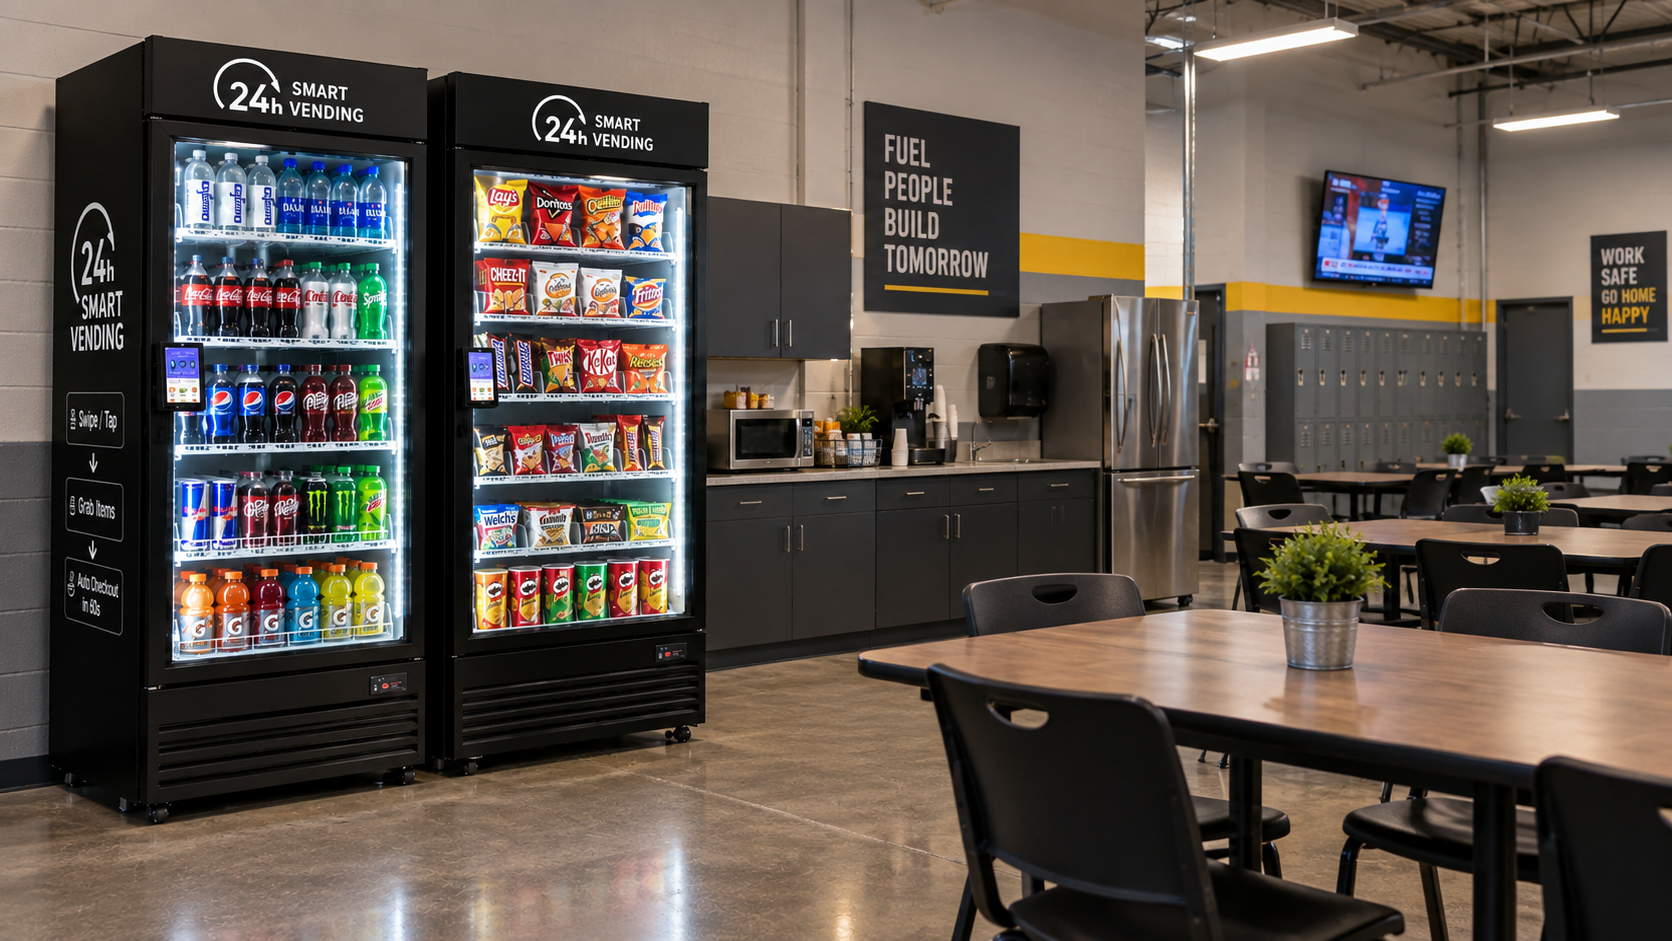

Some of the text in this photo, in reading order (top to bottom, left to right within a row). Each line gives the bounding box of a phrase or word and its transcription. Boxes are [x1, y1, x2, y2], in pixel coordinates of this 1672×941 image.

[229, 81, 283, 115] 24h
[291, 81, 349, 101] SMART
[289, 101, 364, 123] VENDING
[595, 115, 641, 132] SMART
[545, 115, 588, 145] 24h
[592, 133, 653, 151] VENDING
[884, 133, 930, 168] FUEL
[884, 170, 953, 206] PEOPLE
[884, 207, 940, 240] BUILD
[81, 238, 115, 286] 24h
[884, 243, 989, 278] TOMORROW
[1601, 246, 1645, 266] WORK
[1601, 267, 1638, 286] SAFE
[81, 290, 123, 320] SMART
[1601, 287, 1657, 305] GO HOME
[1602, 305, 1650, 325] HAPPY
[70, 322, 124, 351] VENDING
[79, 410, 98, 430] Swipe
[104, 411, 117, 432] Tap
[78, 497, 116, 520] Grab Items
[77, 573, 119, 598] Auto Checkout
[82, 597, 101, 617] in 60s
